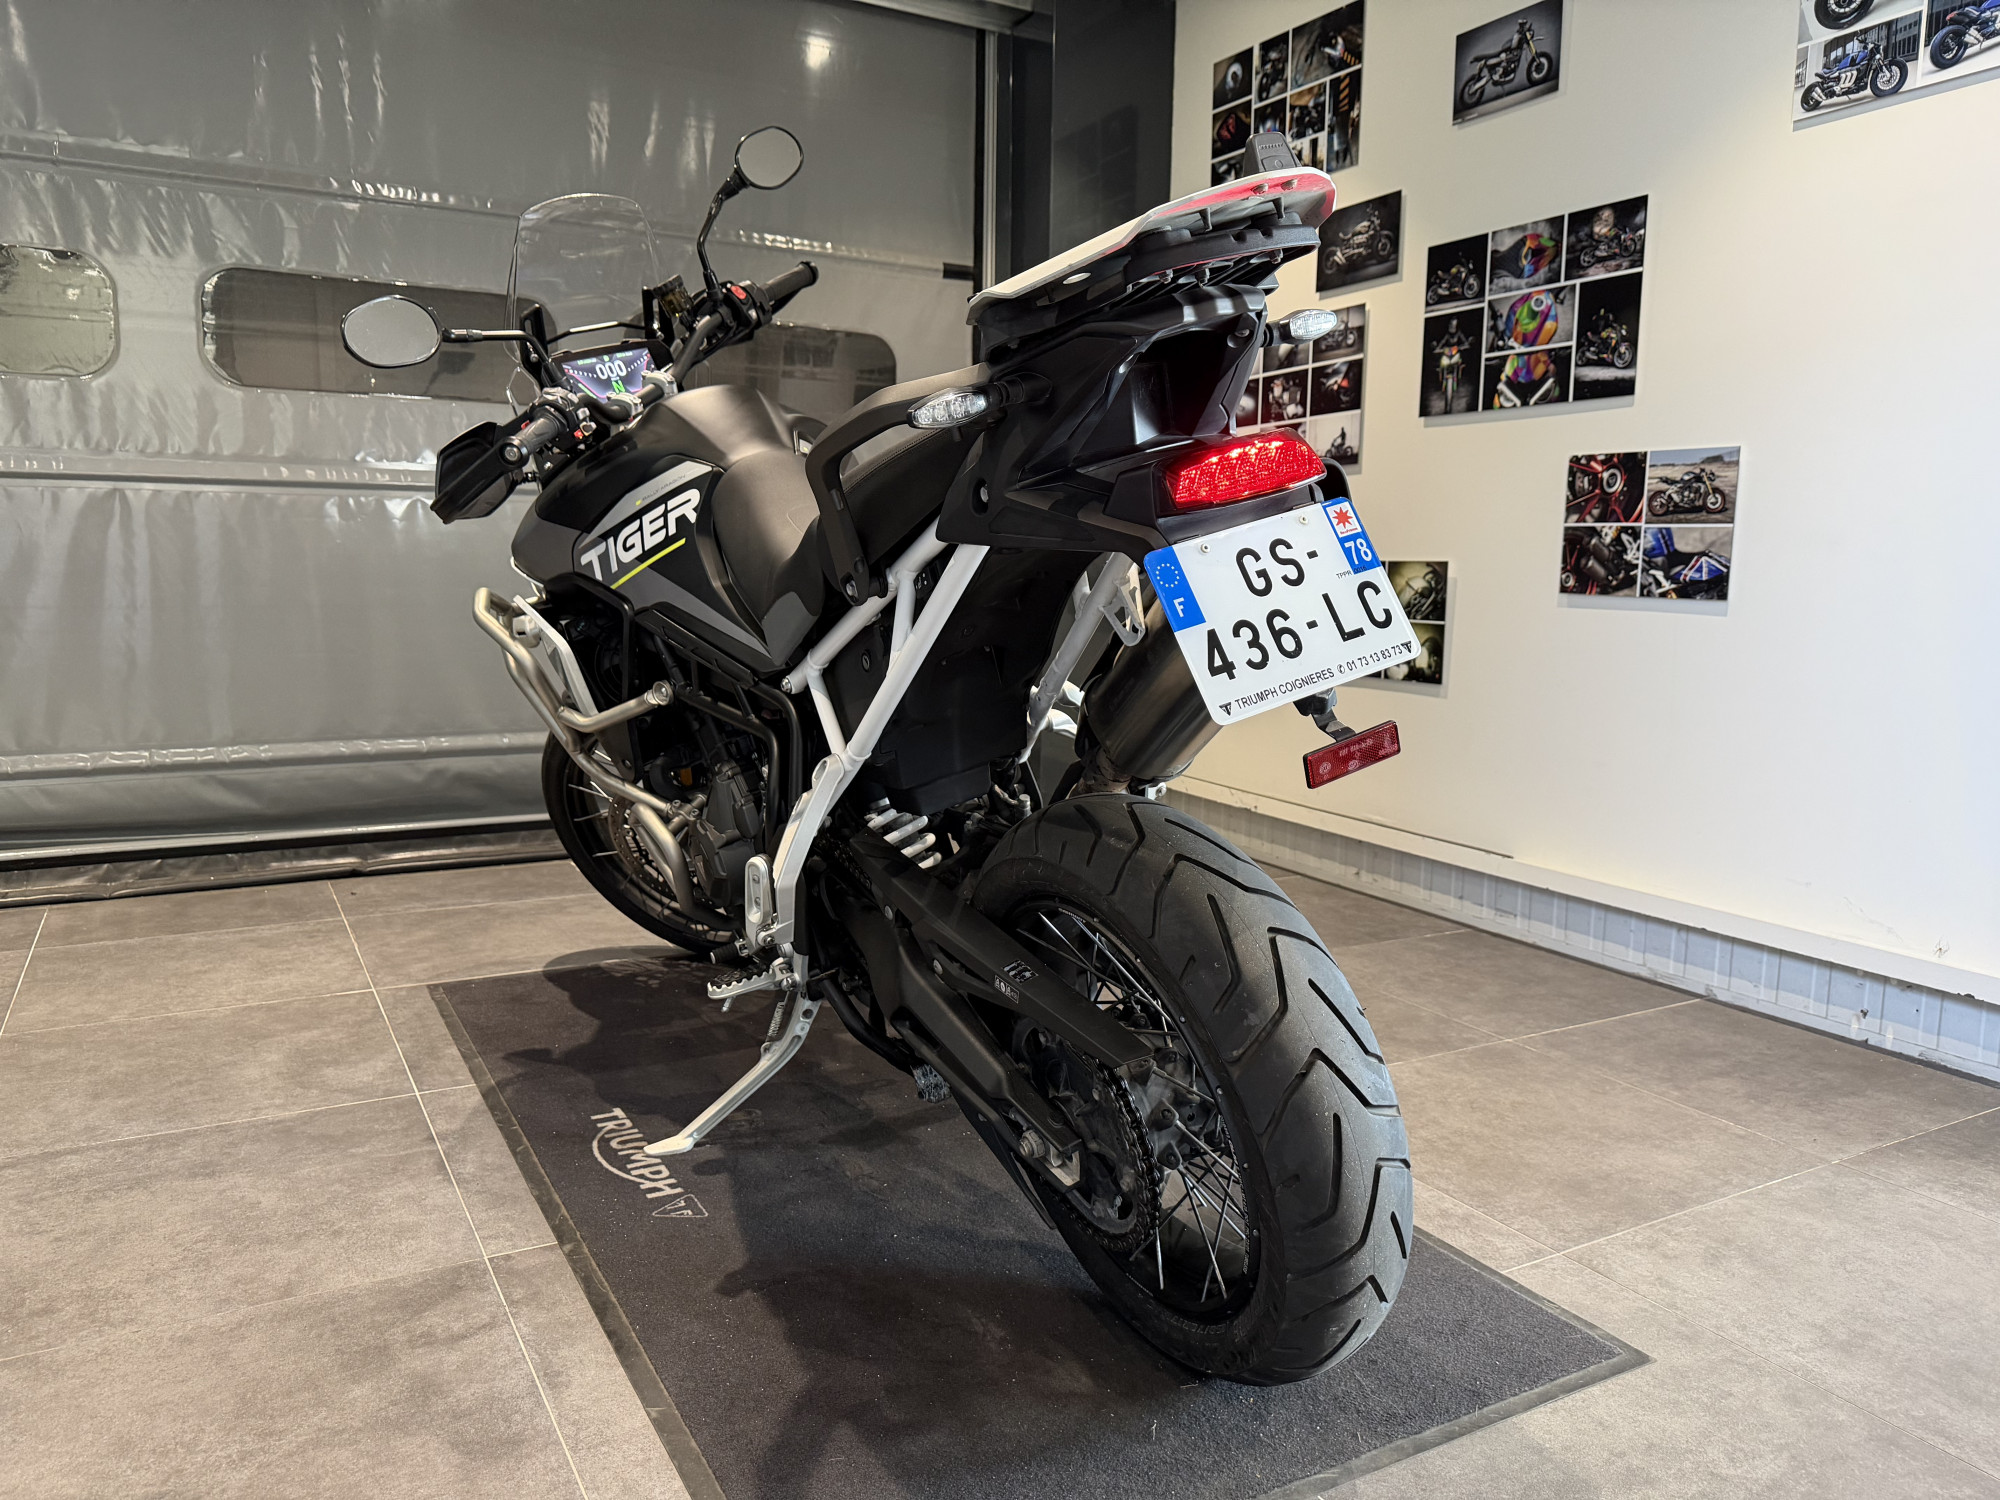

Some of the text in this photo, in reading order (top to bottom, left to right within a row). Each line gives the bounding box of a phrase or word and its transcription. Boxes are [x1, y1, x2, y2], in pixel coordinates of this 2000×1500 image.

[595, 360, 627, 380] 000
[612, 379, 626, 394] N
[580, 488, 701, 582] TIGER
[1344, 538, 1373, 565] 78
[1173, 597, 1185, 618] F
[1235, 644, 1403, 710] TRIUMPH COIGNIERES 01 73 13 83 73
[590, 1107, 685, 1199] TRIUMPH
